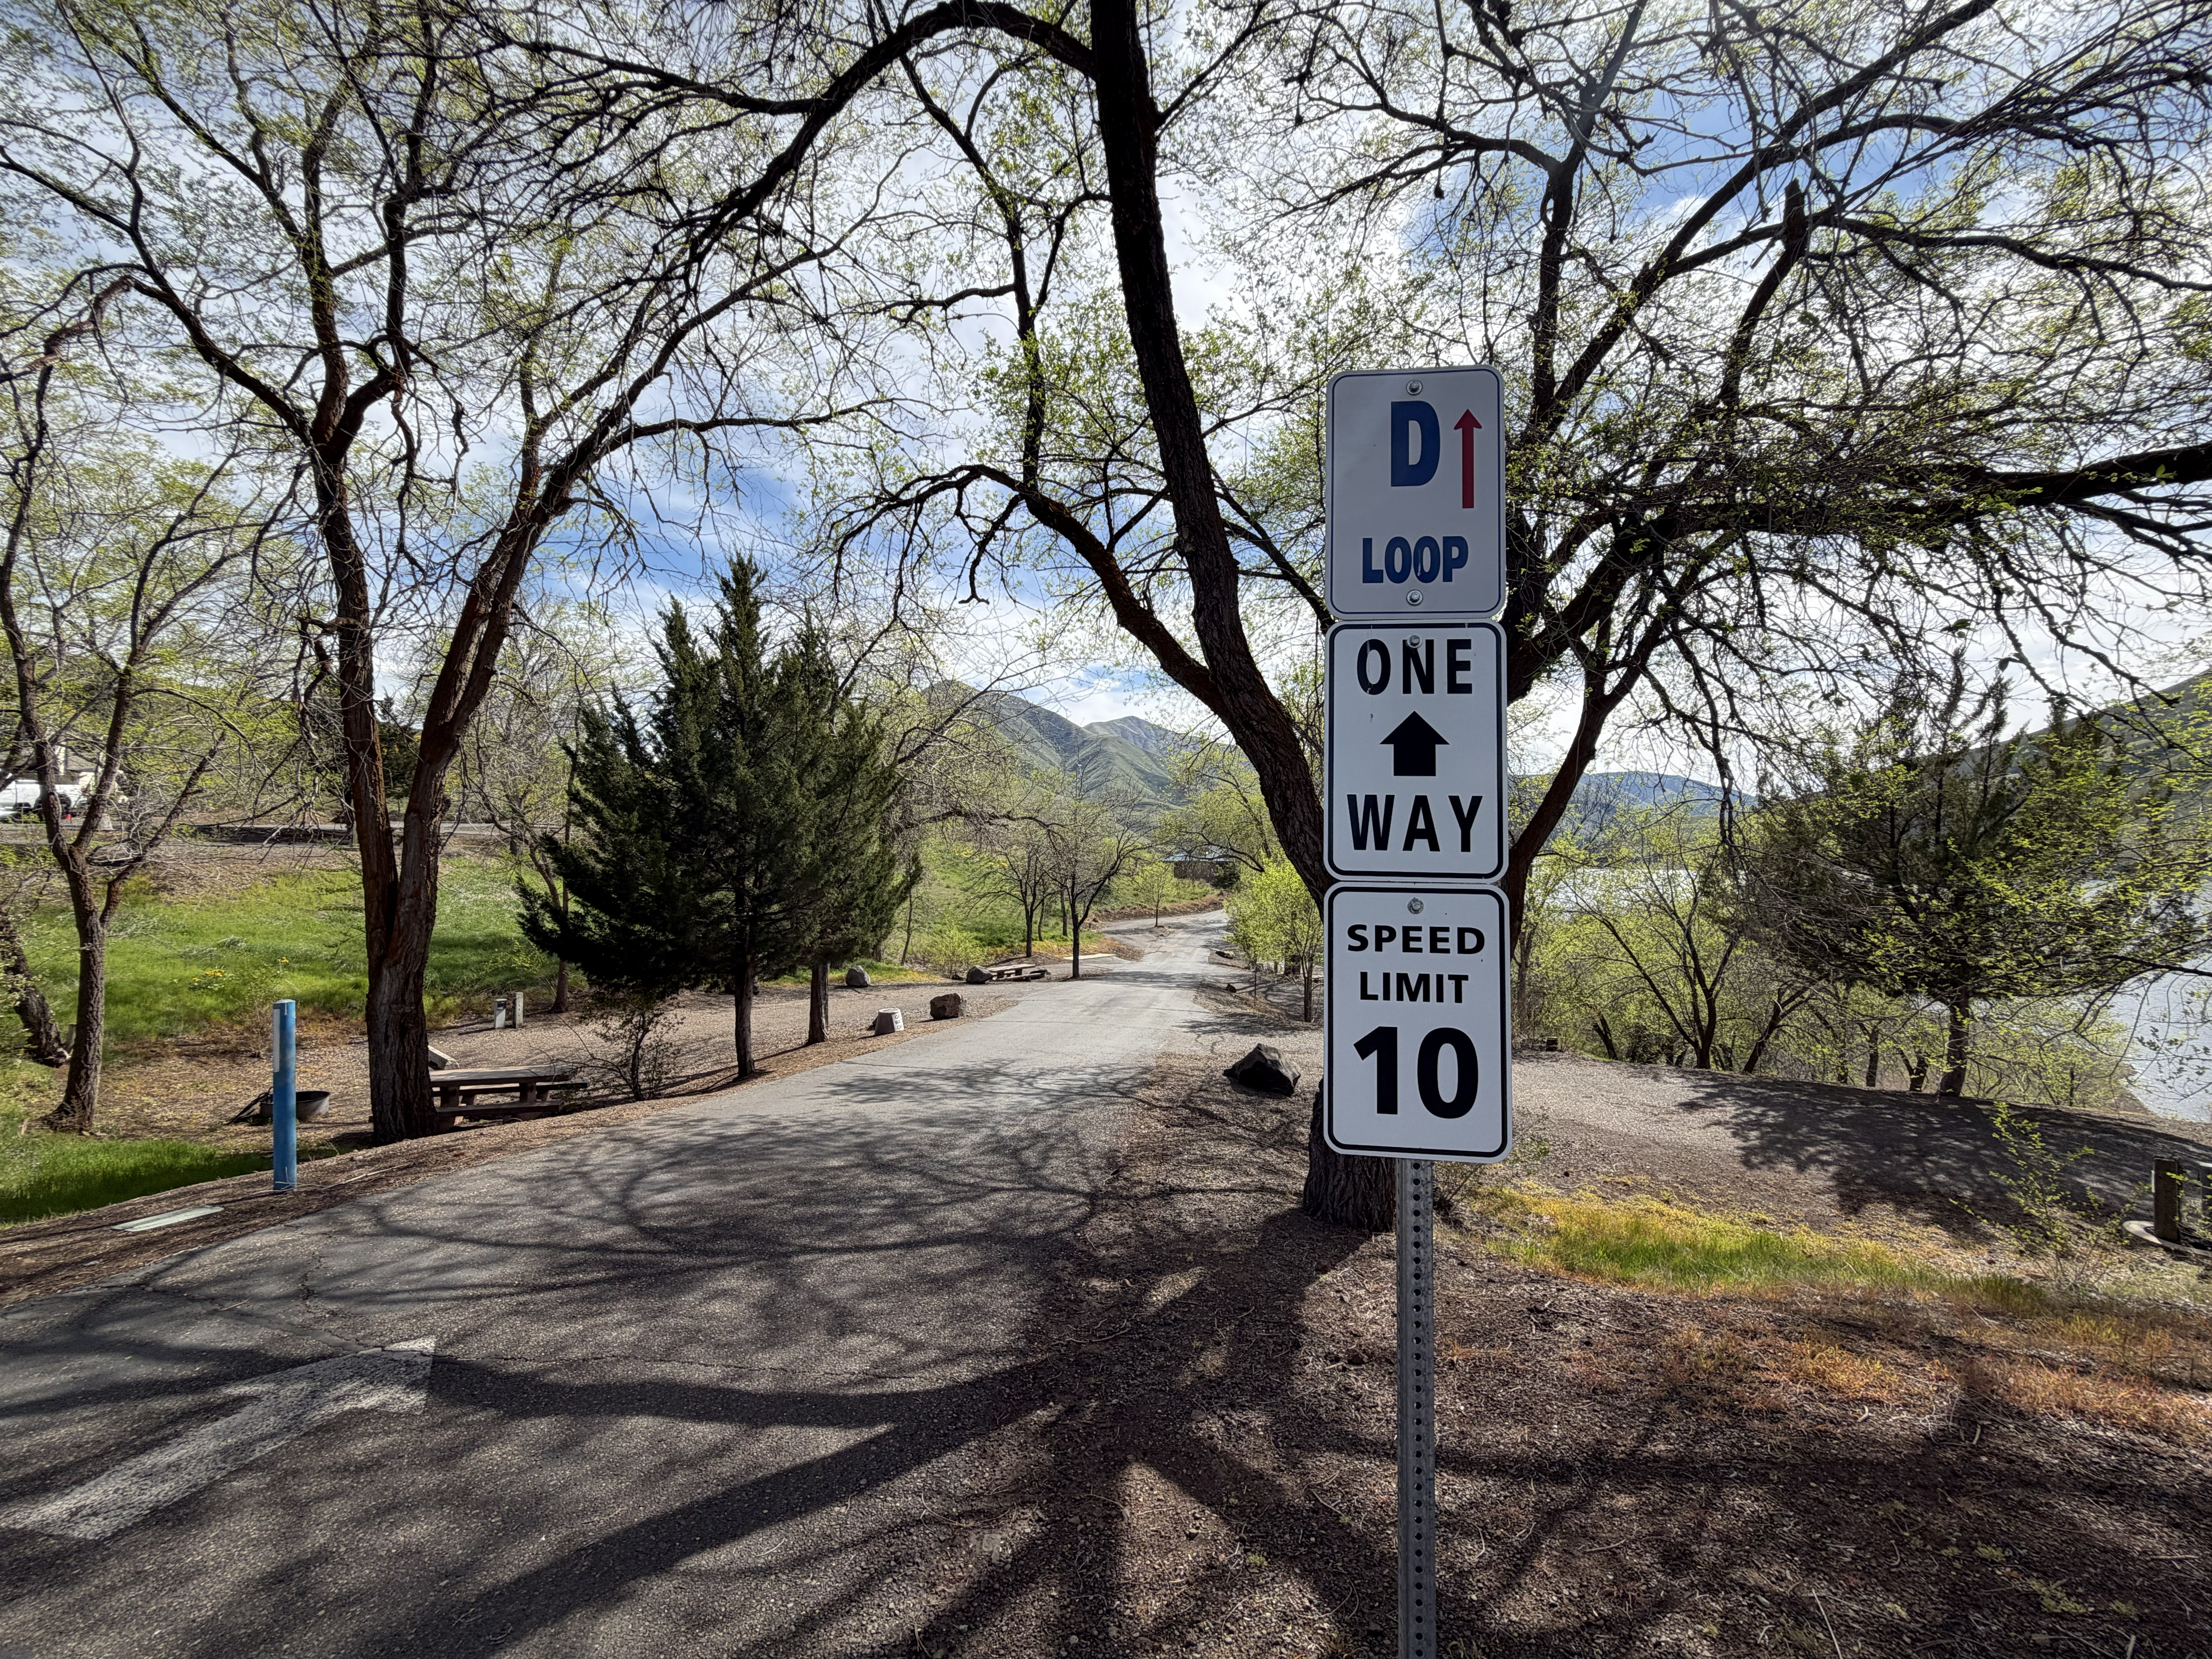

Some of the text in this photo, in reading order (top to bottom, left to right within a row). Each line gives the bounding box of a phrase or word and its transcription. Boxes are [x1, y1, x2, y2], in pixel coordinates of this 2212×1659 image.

[1391, 400, 1441, 487] D
[1362, 536, 1468, 584] LOOP
[1357, 639, 1472, 695] ONE
[1346, 794, 1483, 852] WAY
[1347, 924, 1485, 955] SPEED
[1360, 971, 1469, 1003] LIMIT
[1353, 1026, 1479, 1119] 10
